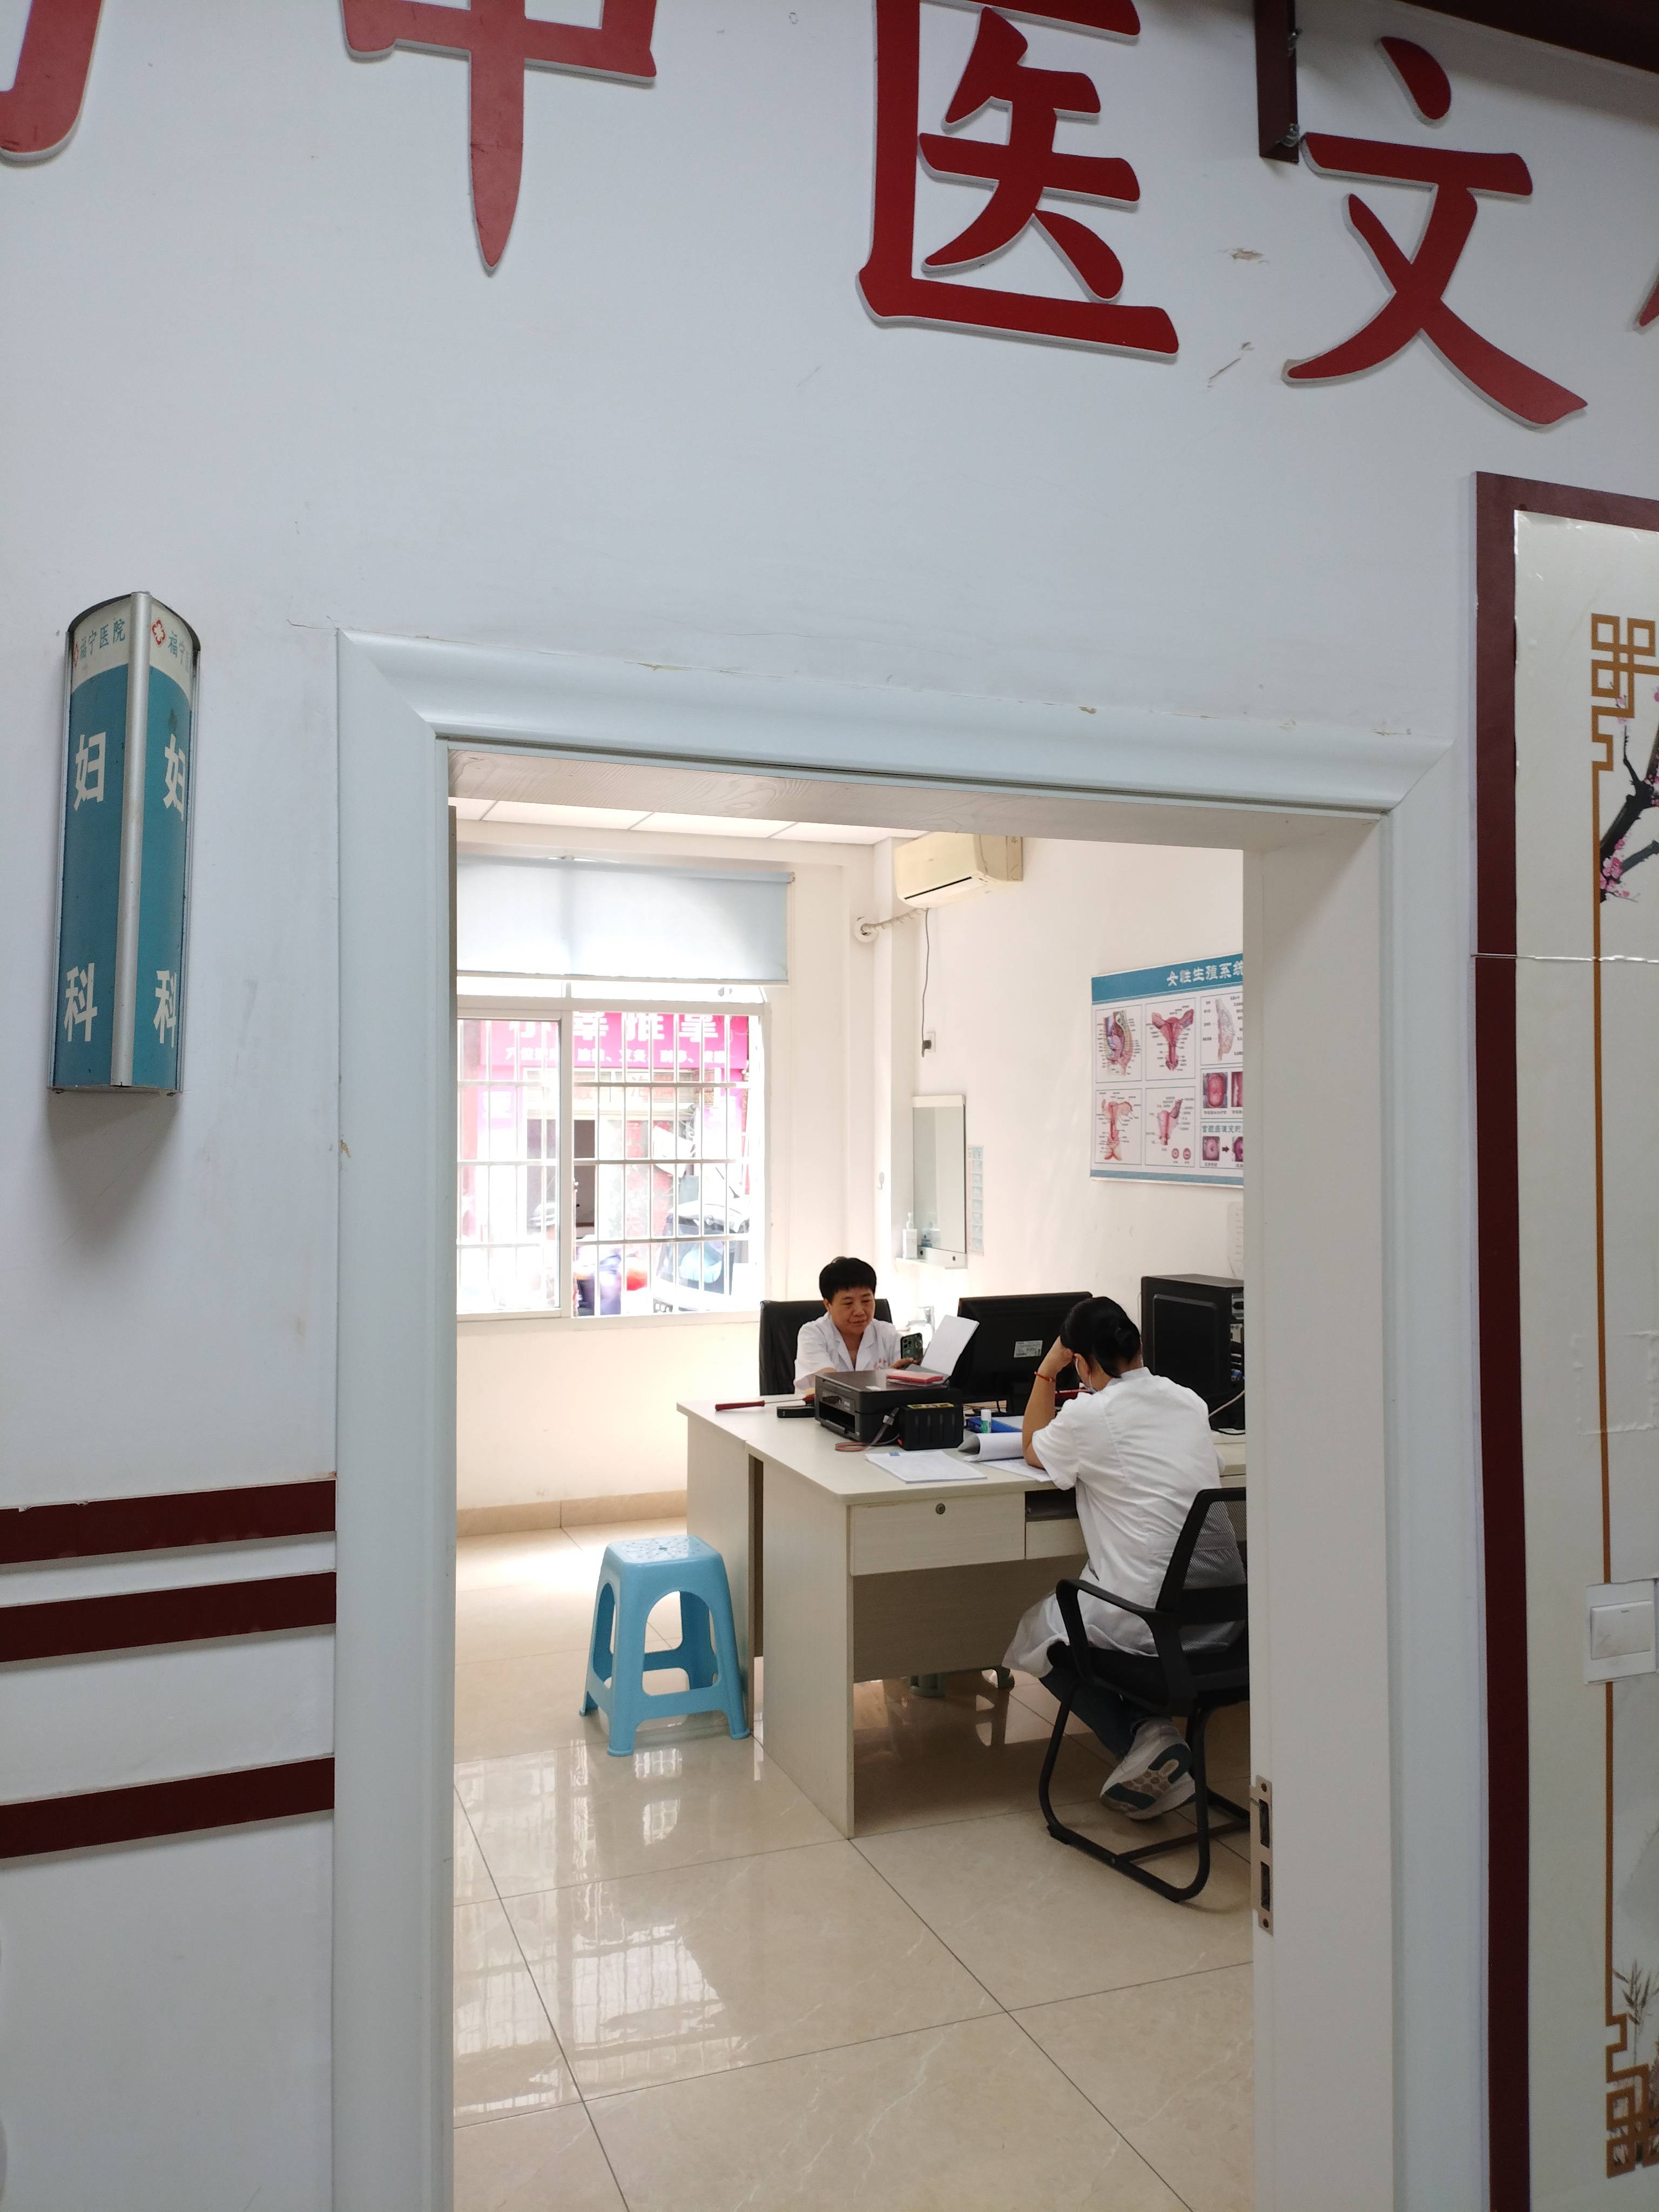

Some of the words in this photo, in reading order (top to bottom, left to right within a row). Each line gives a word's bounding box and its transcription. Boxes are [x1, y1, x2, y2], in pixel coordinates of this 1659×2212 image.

[0, 0, 1659, 429] 中医文
[64, 732, 106, 1042] 妇科
